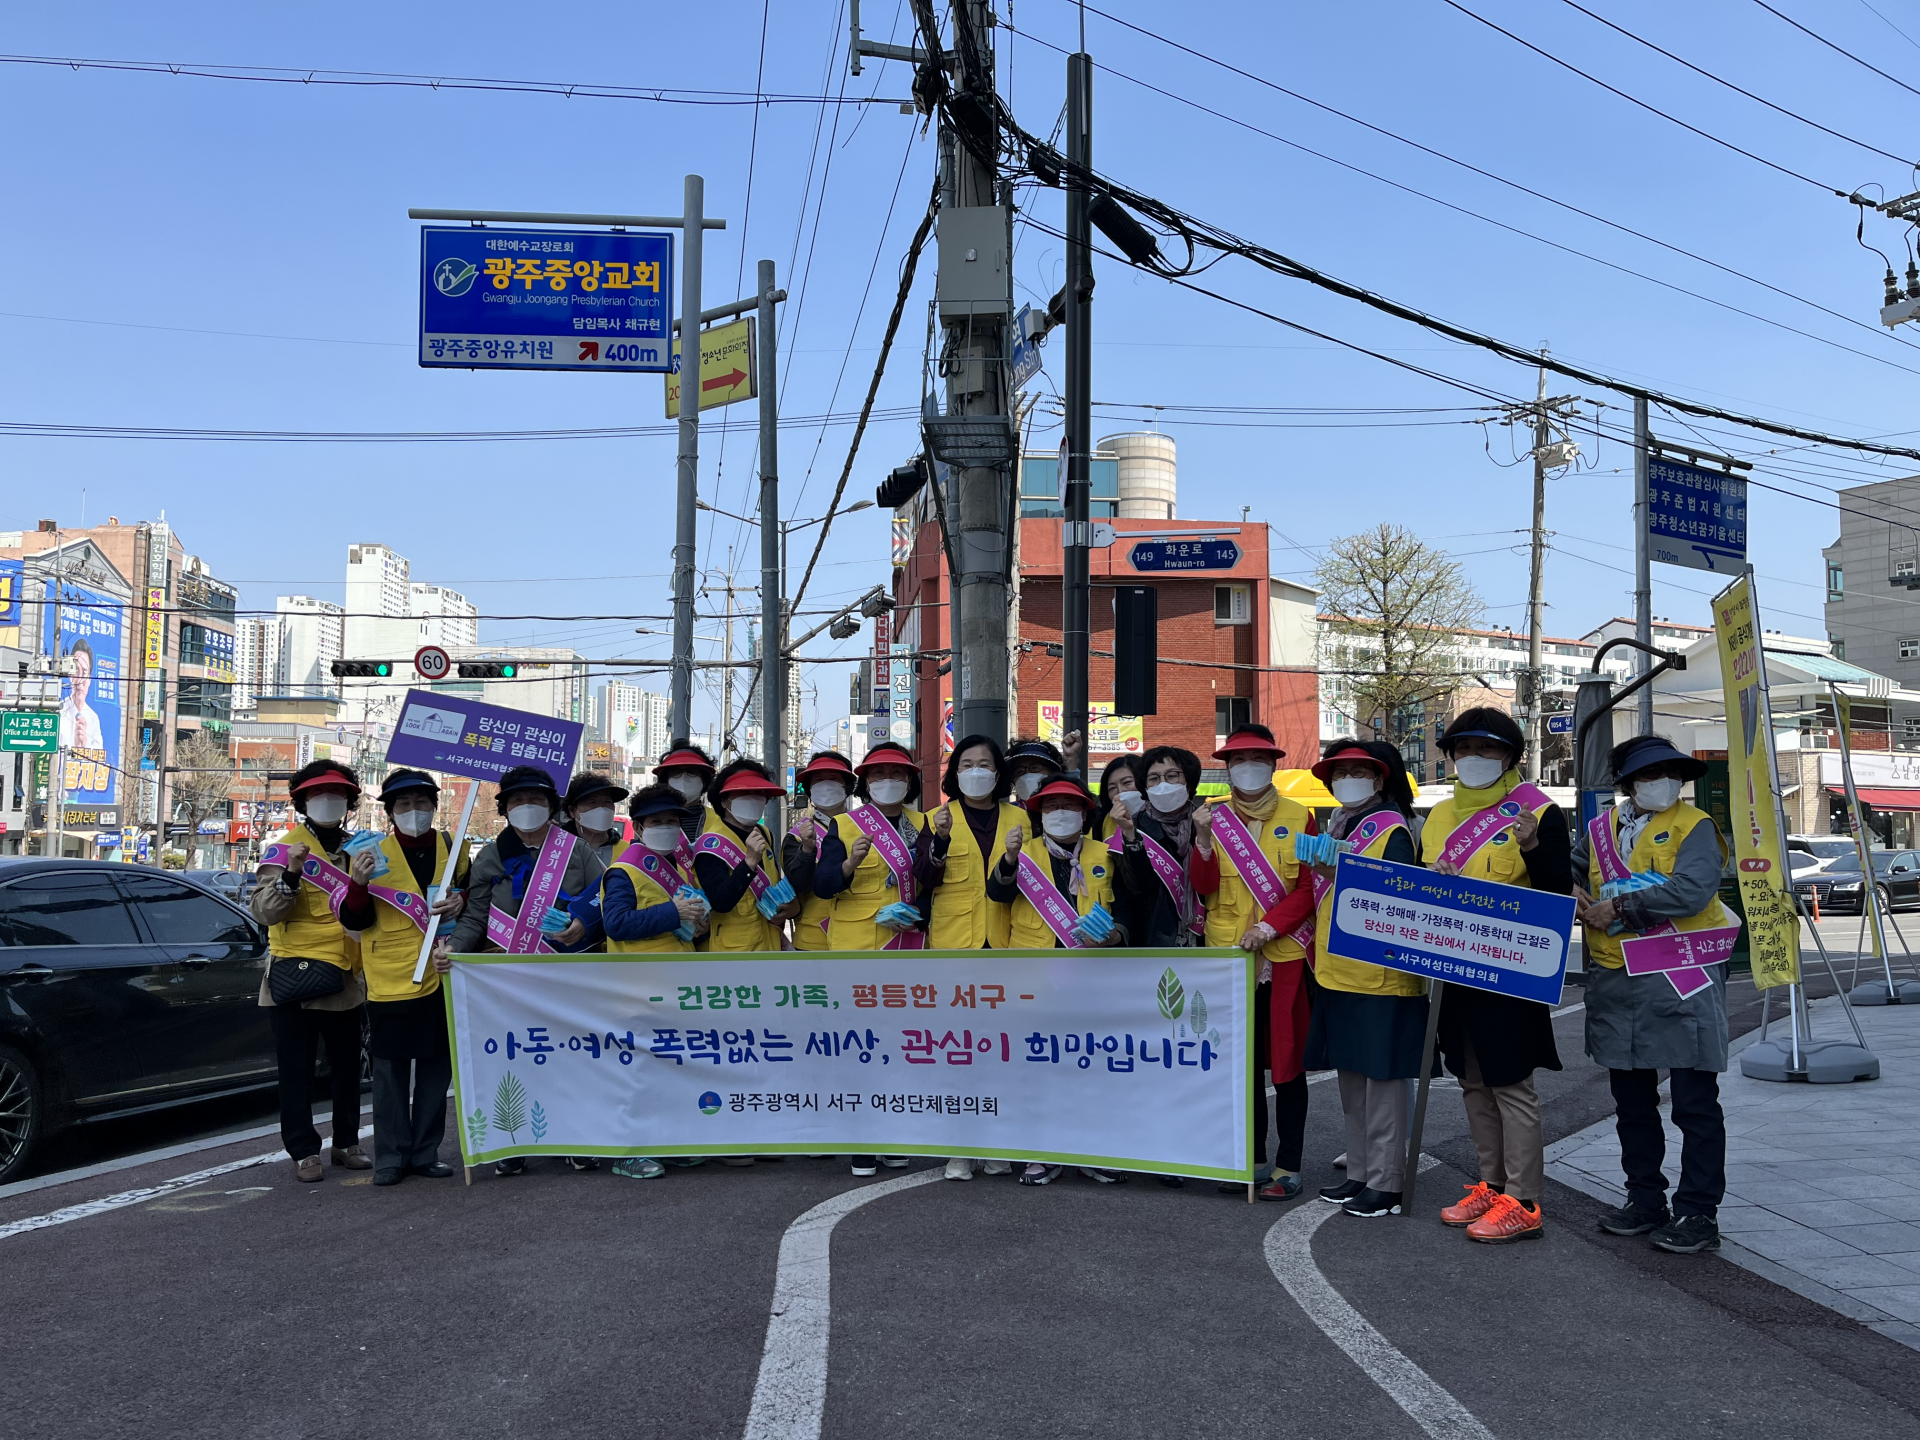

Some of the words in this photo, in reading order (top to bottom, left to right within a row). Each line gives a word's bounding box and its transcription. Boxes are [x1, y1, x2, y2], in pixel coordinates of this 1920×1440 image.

[486, 239, 574, 253] 대한예수교장로회
[483, 257, 660, 293] 광주중앙교회
[482, 292, 522, 305] Gwangju
[524, 293, 568, 306] Joongang
[628, 295, 660, 307] Church
[572, 317, 621, 331] 담임목사
[625, 318, 661, 331] 채규현
[428, 338, 554, 361] 광주중앙유치원
[605, 344, 659, 362] 400m
[1025, 350, 1038, 368] Stn
[1649, 463, 1746, 499] 광주보호관찰심사위원회
[1649, 511, 1745, 545] 광주청소년꿈키움센터
[1135, 552, 1154, 562] 149
[1165, 544, 1203, 557] 화운로
[1216, 549, 1234, 560] 145
[1656, 550, 1679, 563] 700m
[151, 544, 164, 580] 간호학원
[1164, 560, 1205, 568] Hwaun-ro
[205, 629, 233, 651] 간호조무
[422, 655, 443, 670] 60
[892, 648, 913, 718] 사진관
[4, 728, 21, 736] Office
[30, 729, 57, 737] Education
[9, 717, 53, 729] 시교육청
[405, 721, 421, 730] LOOK
[441, 728, 459, 737] AGAIN
[479, 717, 521, 738] 당신의
[524, 726, 566, 748] 관심이
[873, 729, 887, 737] CU
[463, 732, 506, 753] 폭력을
[511, 741, 568, 767] 멈춥니다.
[1126, 740, 1138, 748] 3F
[446, 754, 516, 773] 서구여성단체협의
[65, 761, 109, 791] 장재성
[858, 809, 882, 833] 여성이
[546, 849, 562, 869] 살기
[539, 871, 554, 893] 좋은
[1384, 876, 1416, 891] 아동과
[1421, 885, 1453, 899] 여성이
[1457, 890, 1496, 909] 안전한
[1500, 900, 1521, 915] 서구
[517, 931, 532, 954] 서구
[1364, 918, 1396, 936] 당신의
[1399, 926, 1420, 941] 작은
[1423, 931, 1466, 952] 관심에서
[1469, 942, 1527, 965] 시작됩니다.
[1517, 932, 1551, 950] 근절은
[1398, 951, 1499, 984] 서구여성단체협의회
[677, 984, 761, 1011] 건강한
[774, 984, 840, 1010] 가족,
[852, 984, 937, 1009] 평등한
[950, 984, 1006, 1010] 서구
[484, 1027, 636, 1066] 아동·여성
[650, 1028, 794, 1066] 폭력없는
[805, 1028, 890, 1066] 세상,
[901, 1029, 1011, 1066] 관심이
[1024, 1031, 1218, 1073] 희망입니다
[728, 1092, 819, 1113] 광주광역시
[827, 1092, 863, 1113] 서구
[871, 1092, 999, 1117] 여성단체협의회
